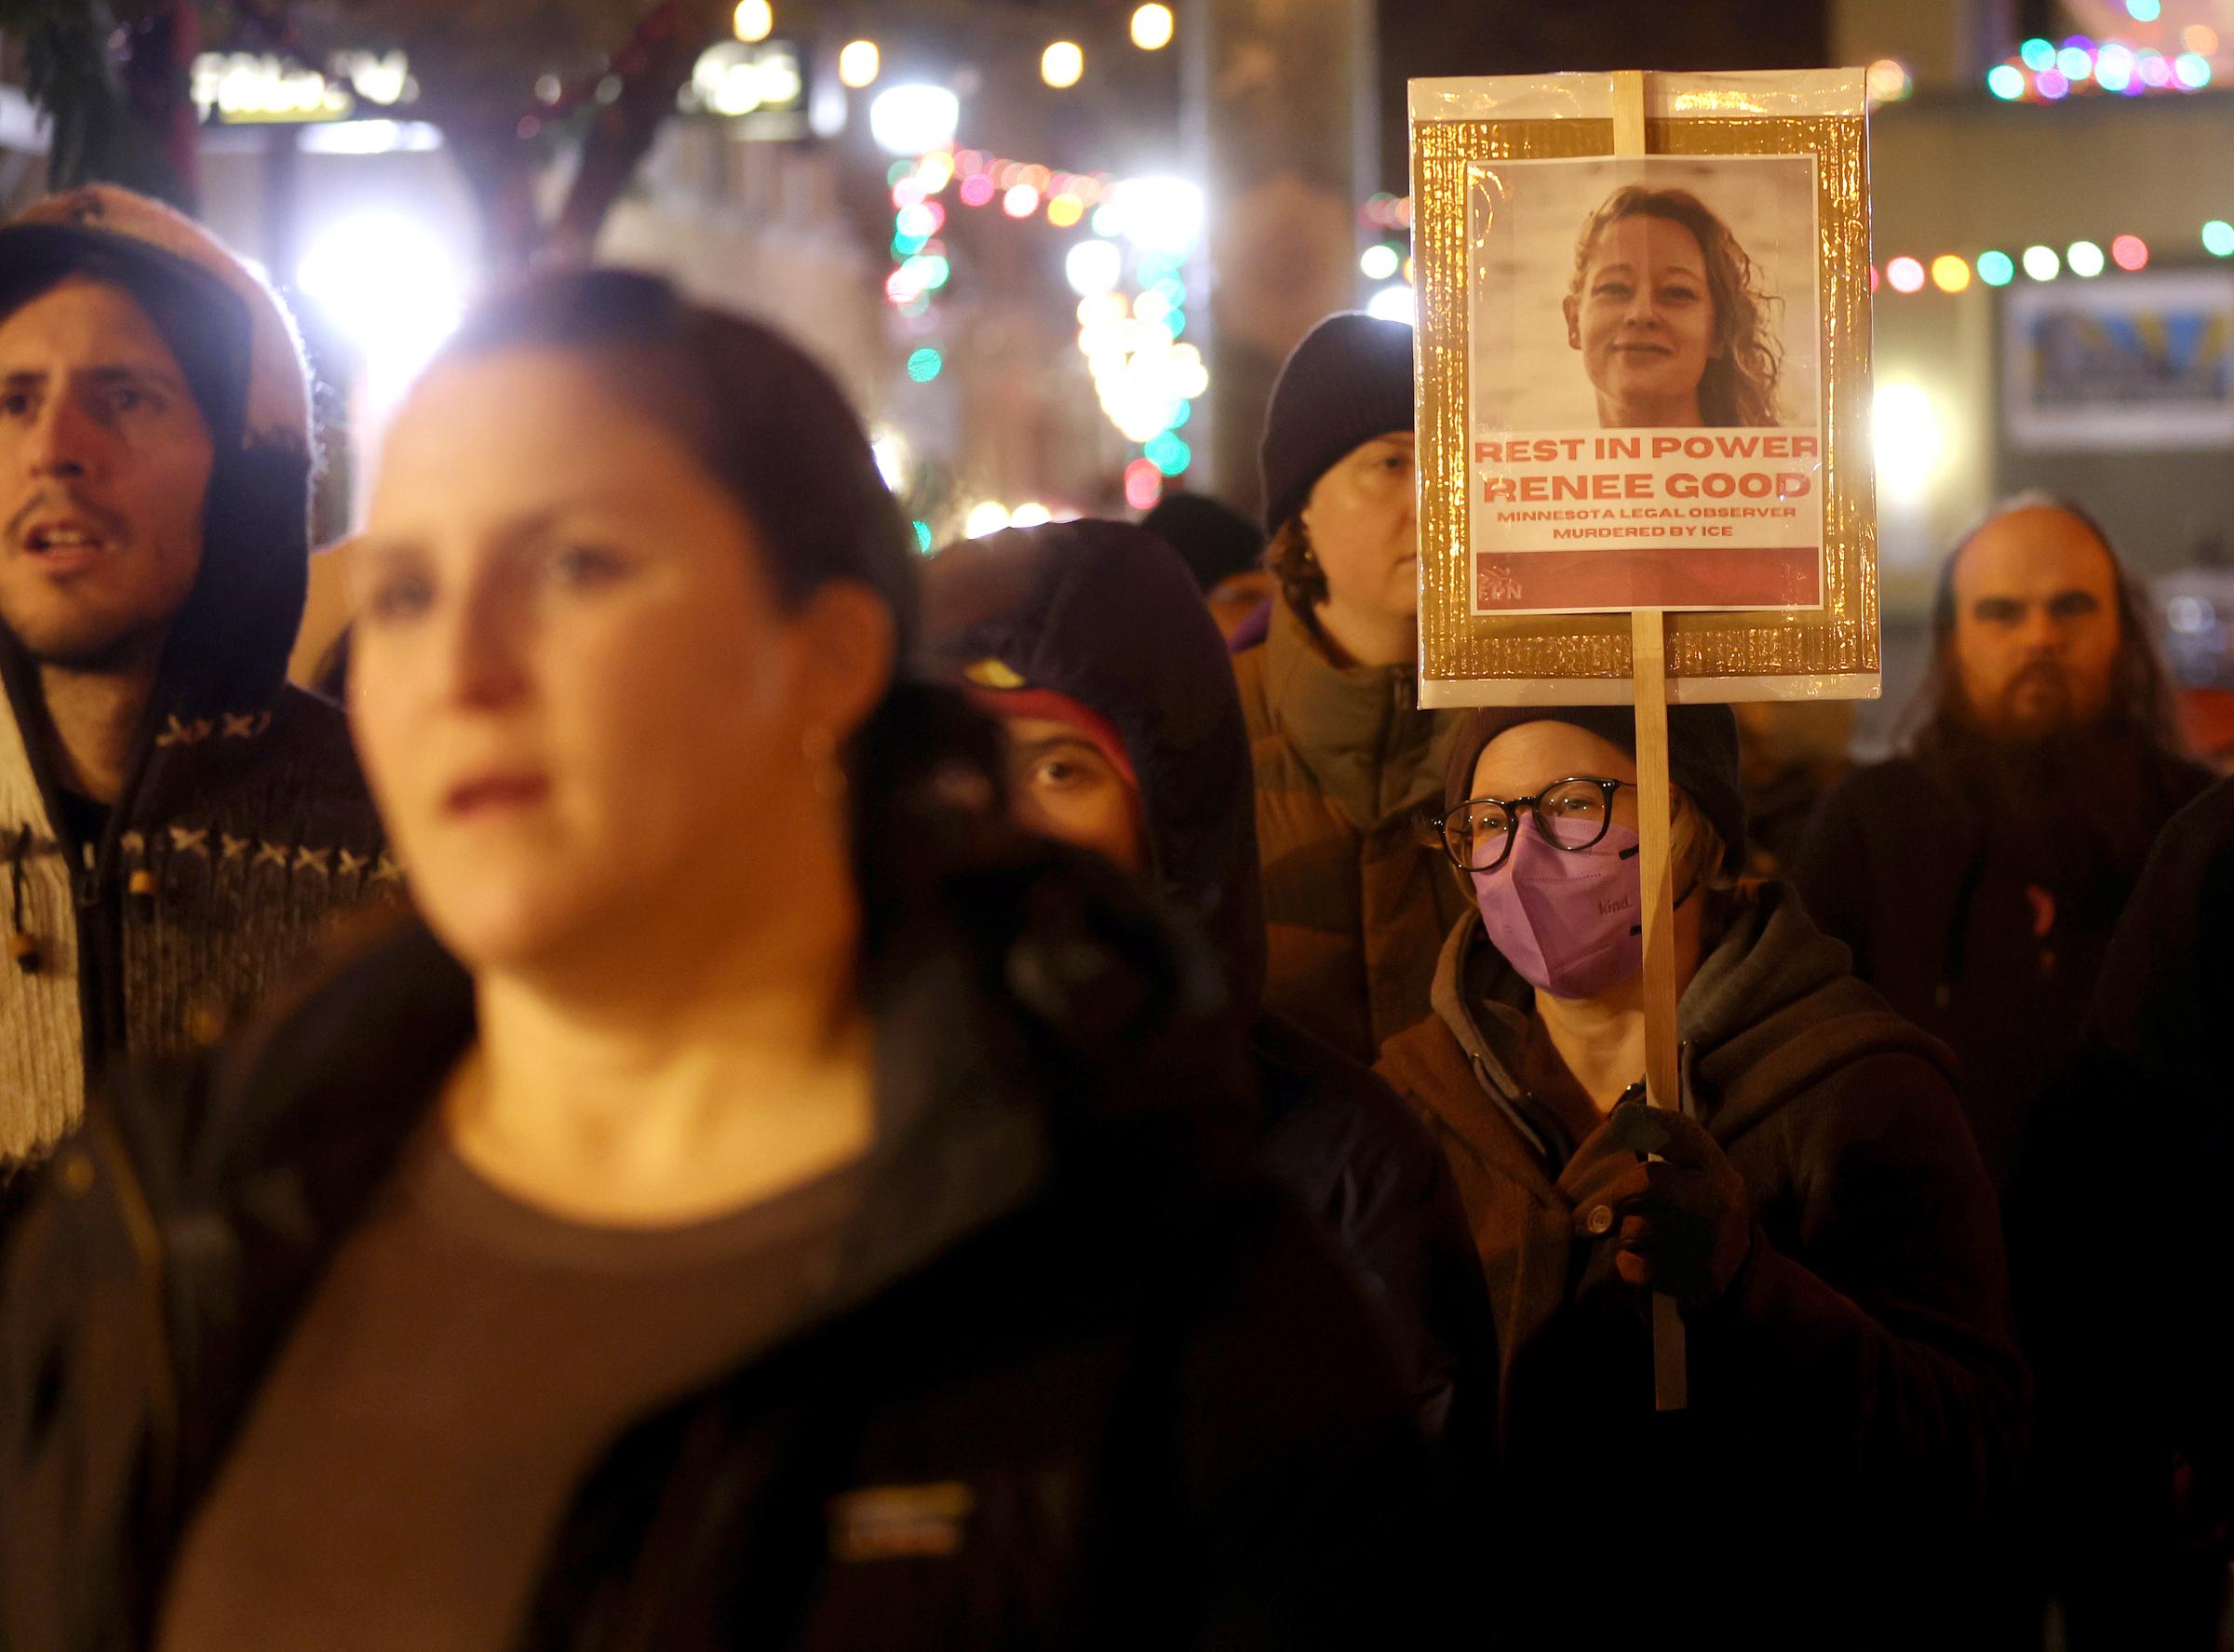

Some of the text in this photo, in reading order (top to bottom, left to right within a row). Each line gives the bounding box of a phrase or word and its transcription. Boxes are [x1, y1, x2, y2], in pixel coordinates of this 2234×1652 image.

[1475, 437, 1818, 463] REST IN POWER
[1484, 473, 1811, 503] RENEE GOOD
[1497, 507, 1797, 522] MINNESOTA LEGAL OBSERVER
[1553, 526, 1734, 539] MURDERED BY ICE
